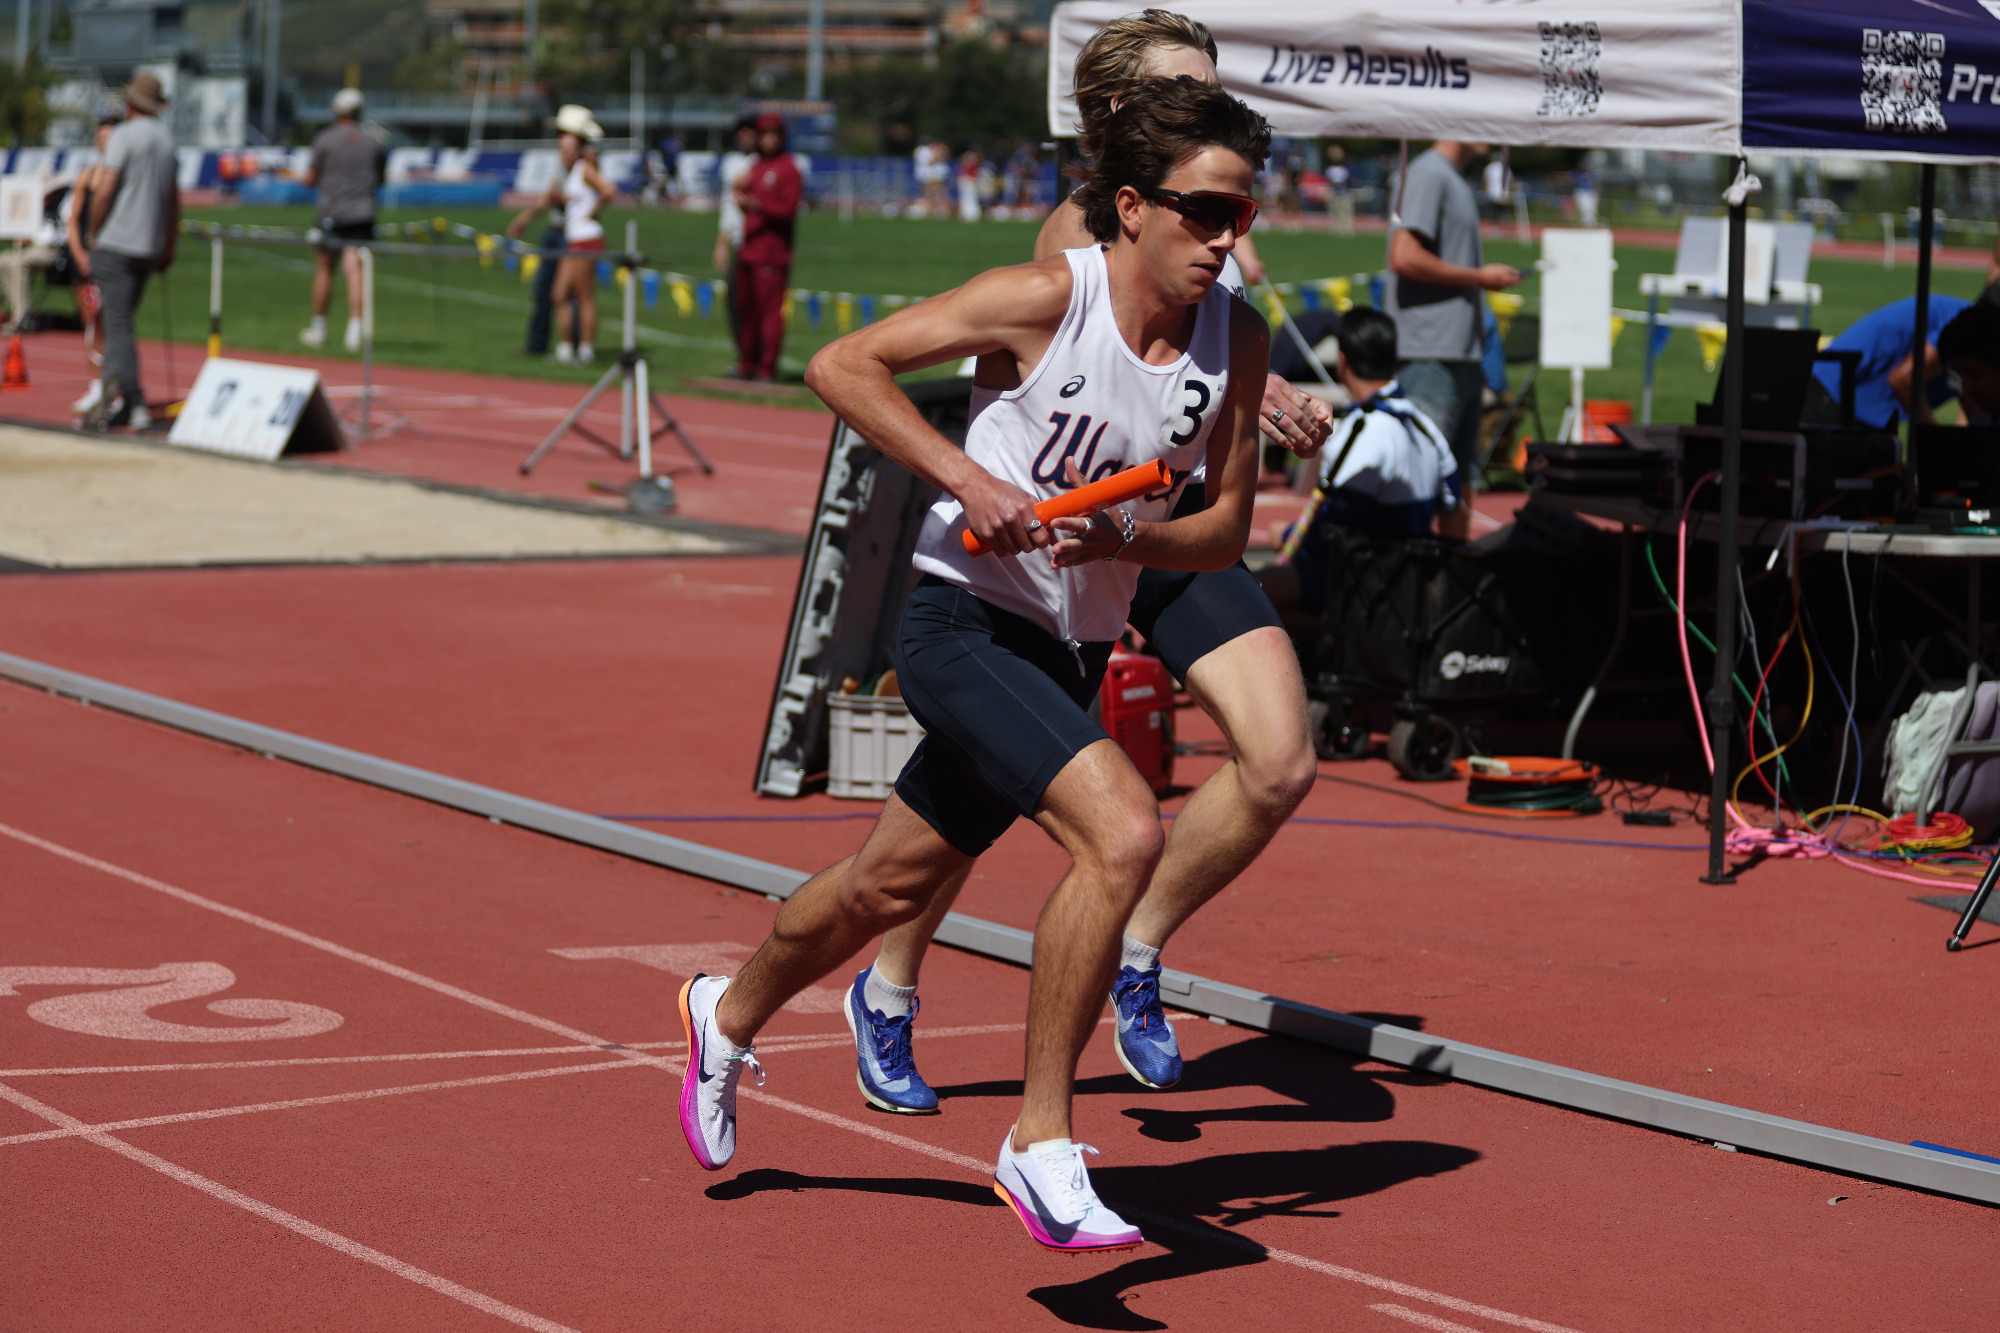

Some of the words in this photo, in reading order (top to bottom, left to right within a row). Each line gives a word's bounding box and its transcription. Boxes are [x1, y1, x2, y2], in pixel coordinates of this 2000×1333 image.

[1262, 44, 1335, 84] Live
[1341, 45, 1471, 89] Results
[1170, 379, 1211, 446] 3
[0, 961, 345, 1043] 2
